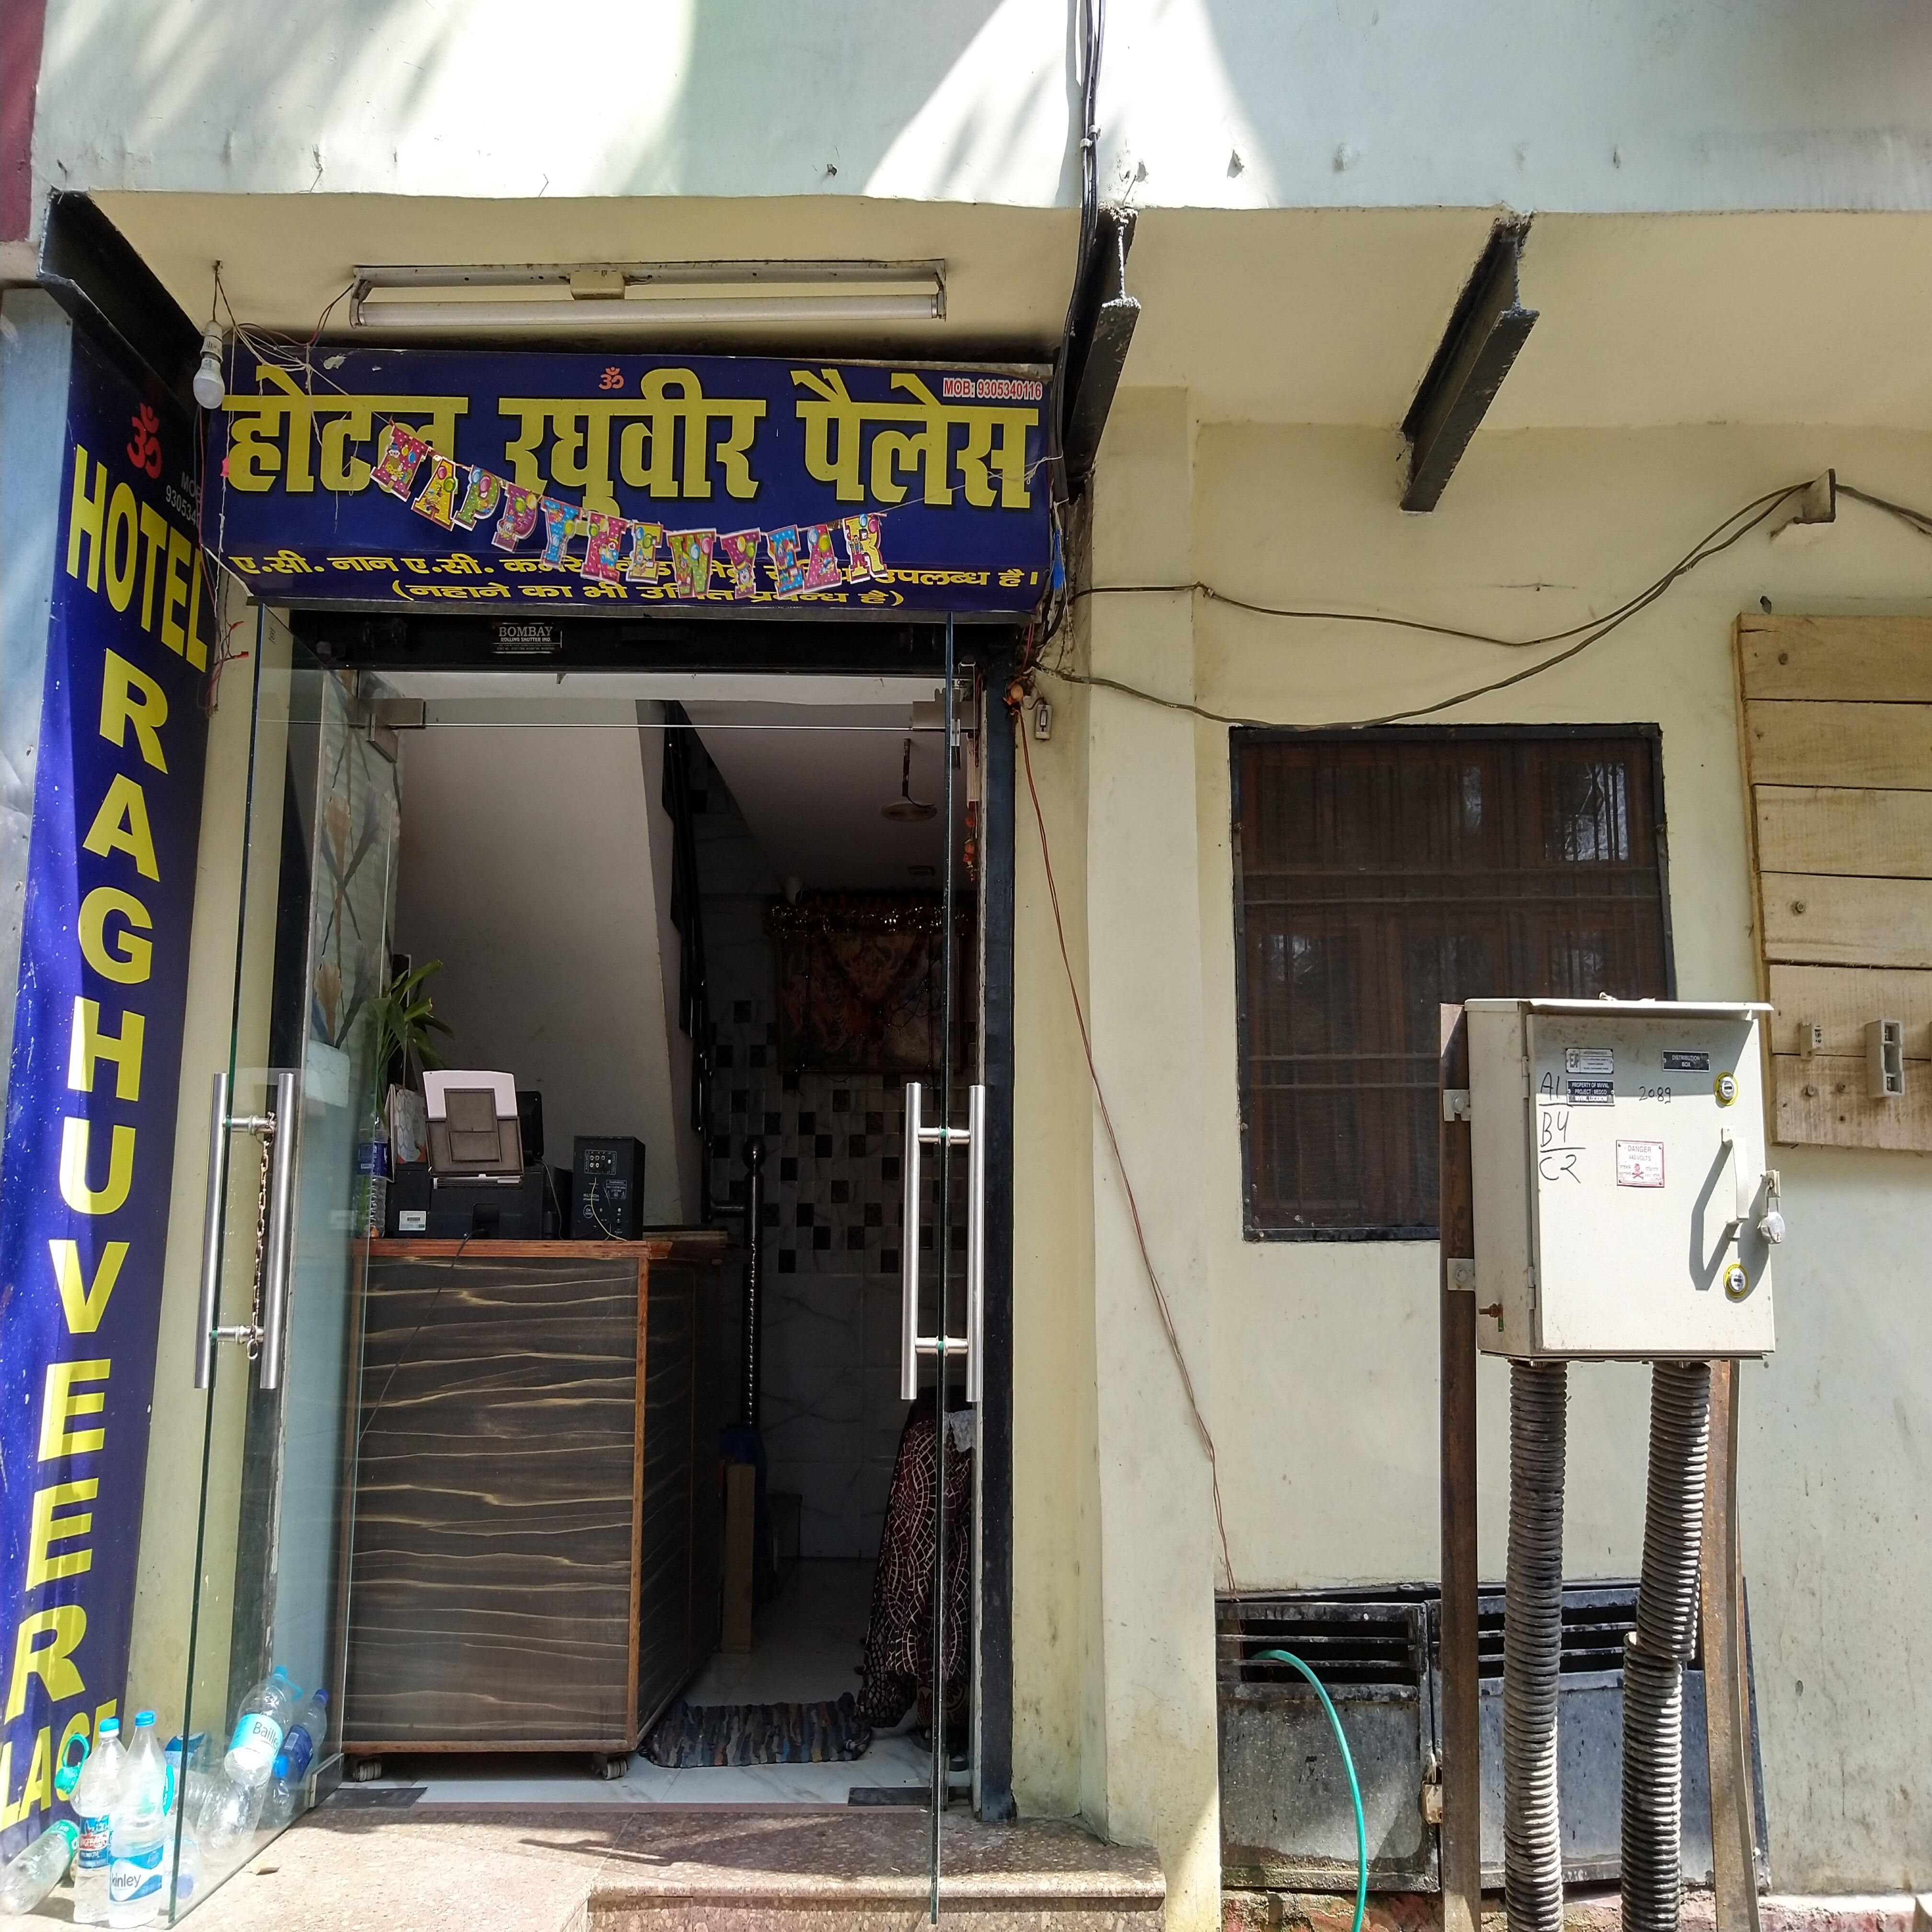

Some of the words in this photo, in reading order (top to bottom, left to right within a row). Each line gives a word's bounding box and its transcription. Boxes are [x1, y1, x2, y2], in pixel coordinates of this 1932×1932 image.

[943, 378, 975, 398] MOB:
[977, 379, 1042, 401] 9305340116
[499, 368, 766, 536] रघुवीर
[791, 368, 1038, 508] पैलेस
[67, 444, 207, 673] HOTEL
[327, 557, 399, 572] नान
[518, 586, 573, 598] का
[583, 582, 628, 598] भी
[499, 627, 553, 636] BOMBAY
[1639, 1086, 1671, 1104] 2089
[4, 648, 168, 1725] RAGHUVEER
[111, 1873, 141, 1887] kinley
